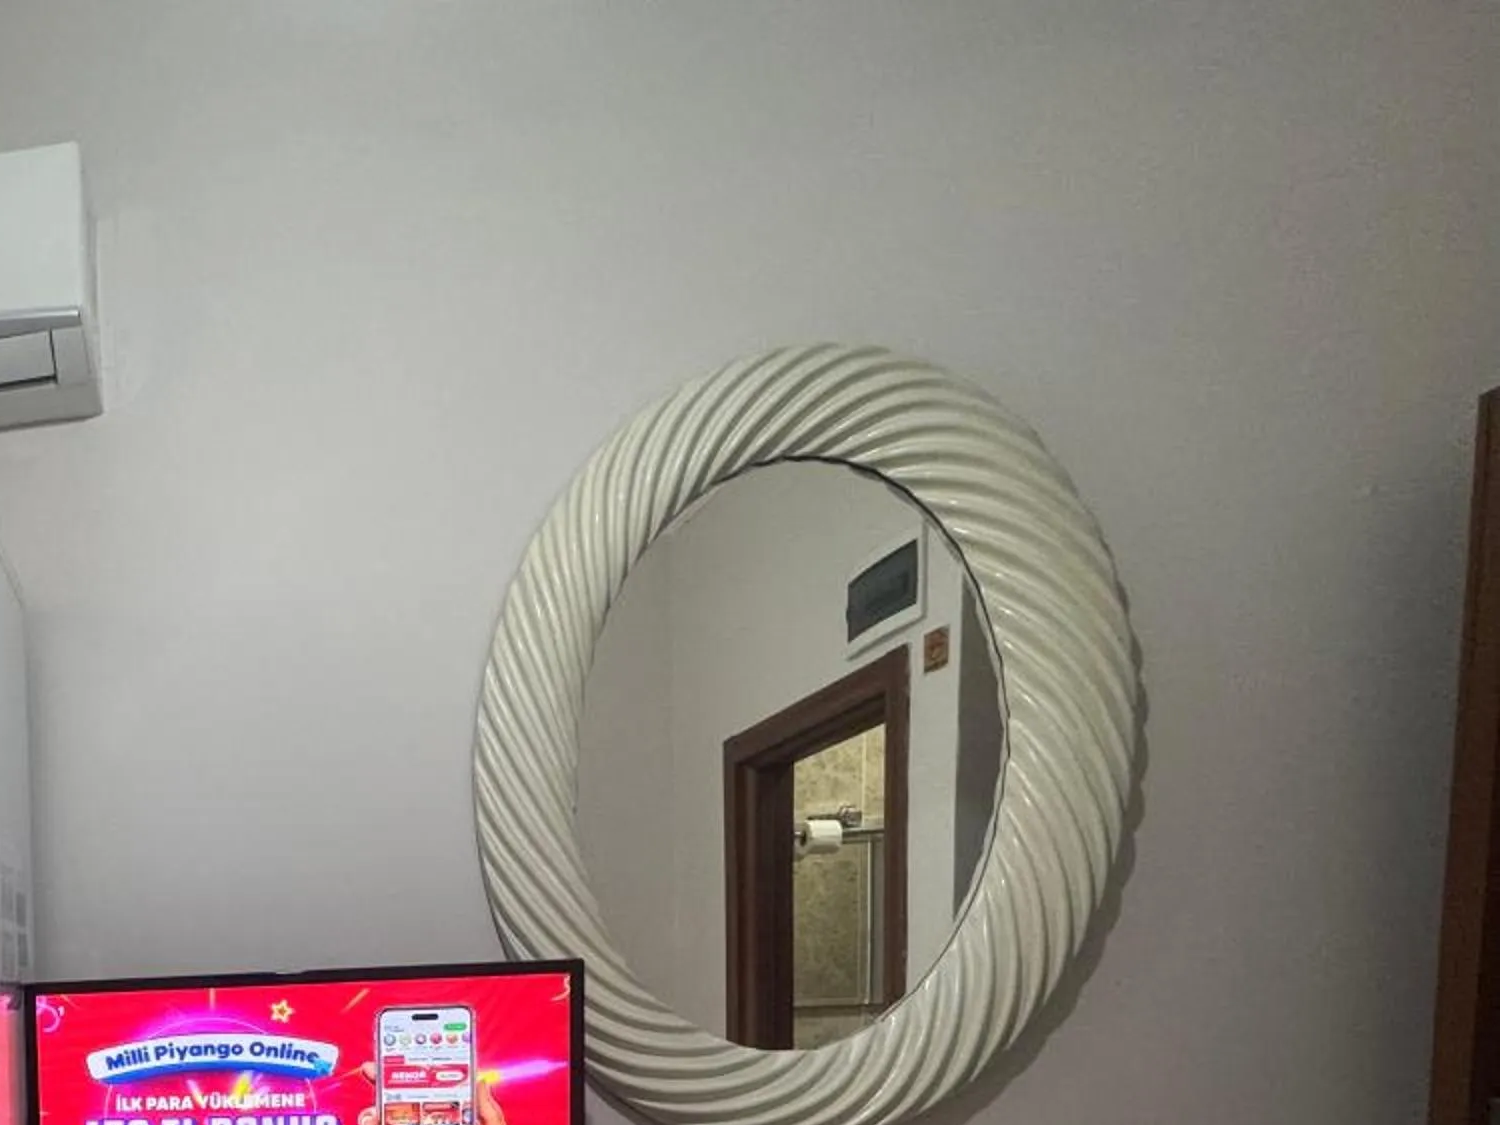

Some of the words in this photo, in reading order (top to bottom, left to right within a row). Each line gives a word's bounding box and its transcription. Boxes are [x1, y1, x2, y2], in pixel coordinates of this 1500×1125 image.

[106, 1047, 149, 1070] Milli
[155, 1042, 243, 1061] Piyango
[116, 1094, 142, 1111] İLK
[146, 1095, 193, 1110] PARA
